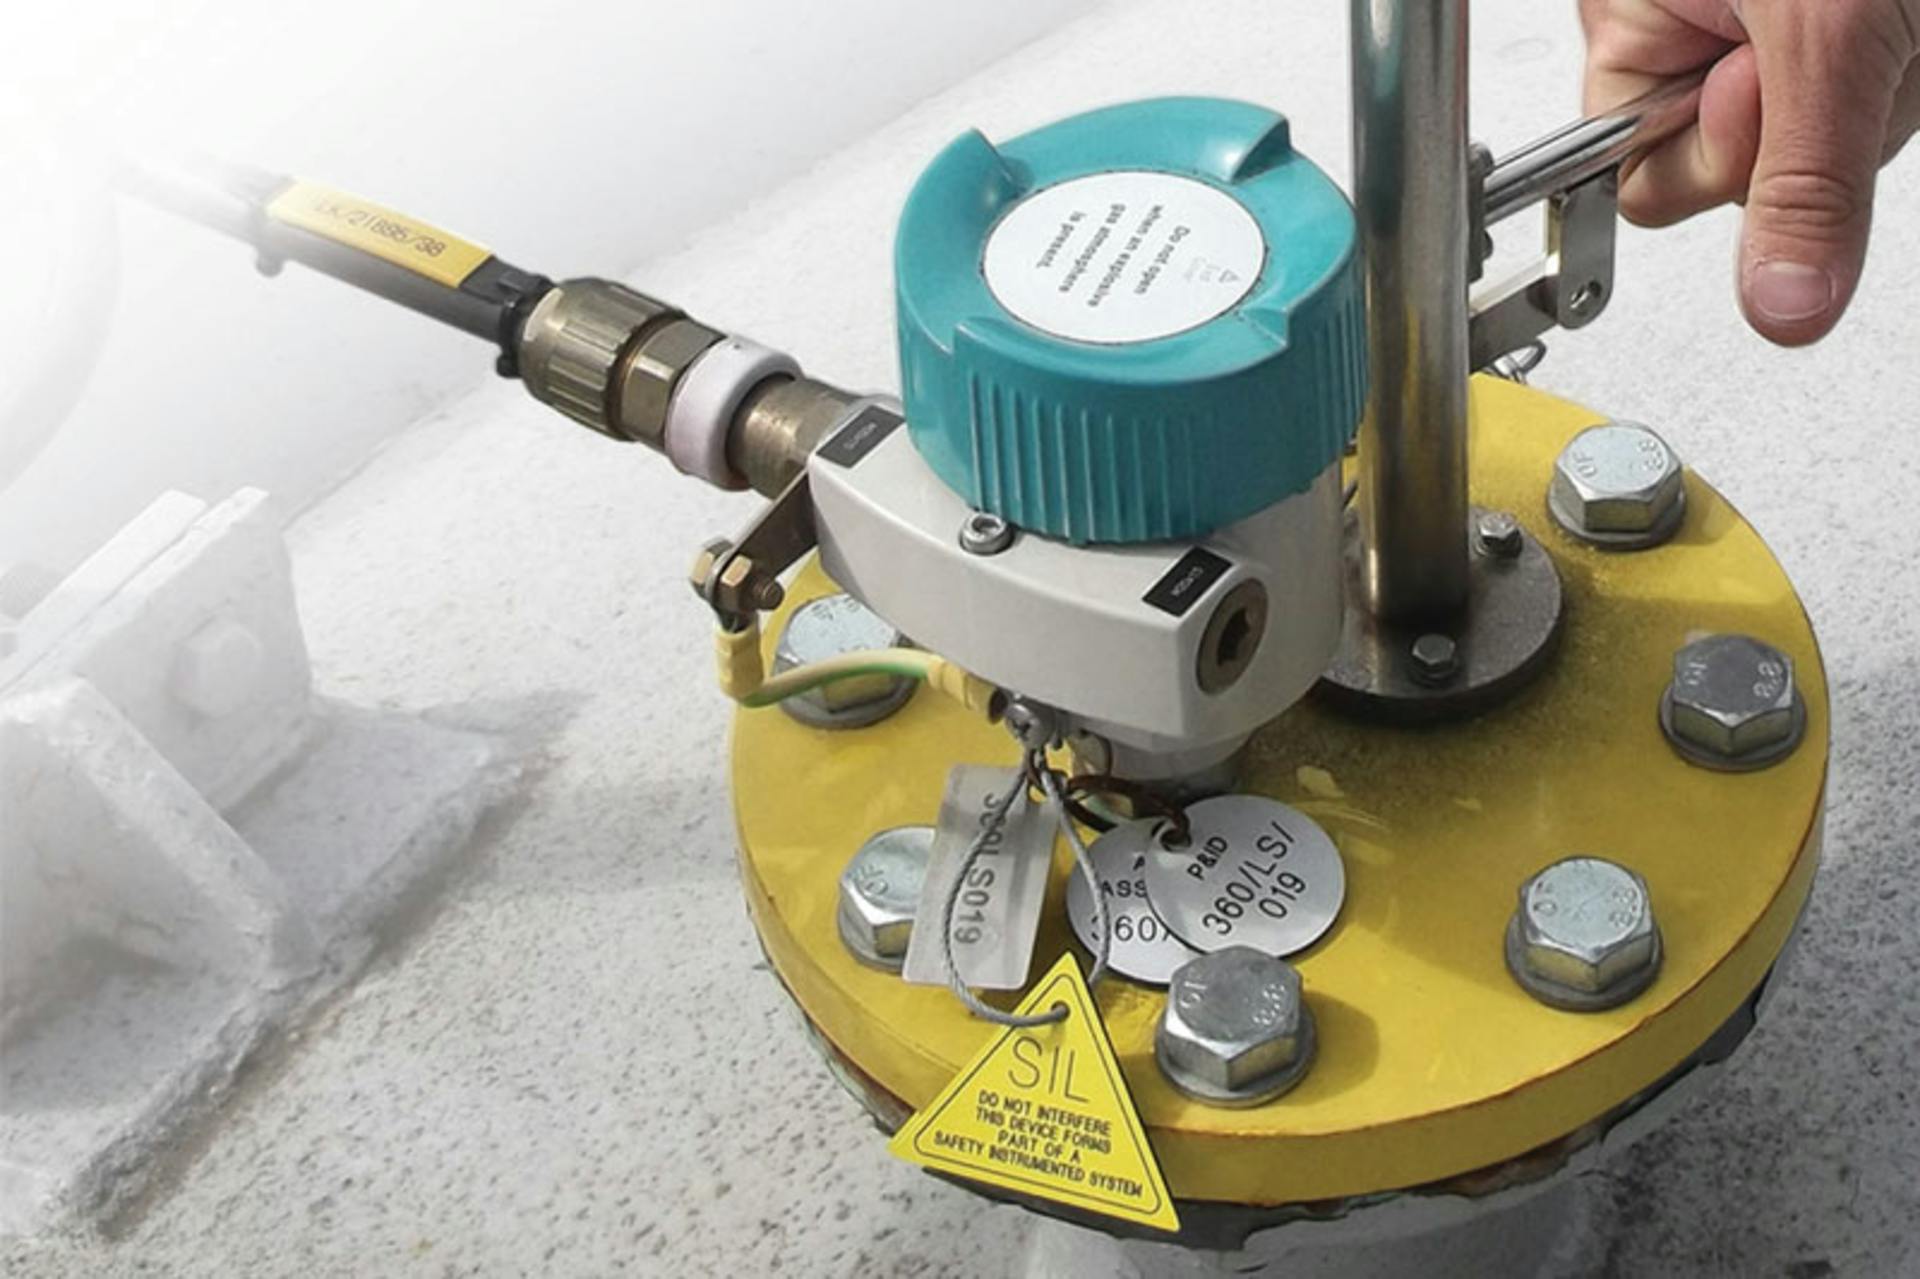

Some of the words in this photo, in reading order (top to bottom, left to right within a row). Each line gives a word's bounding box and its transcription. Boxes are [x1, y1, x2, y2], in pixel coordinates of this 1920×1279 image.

[1106, 203, 1126, 224] gas
[1136, 205, 1163, 234] when
[1169, 225, 1191, 243] Do
[1036, 223, 1075, 268] present.
[1058, 226, 1110, 292] atmosphere
[1125, 236, 1142, 251] an
[1153, 244, 1174, 264] not
[1087, 253, 1131, 307] explosive
[1133, 265, 1161, 294] open
[1187, 836, 1228, 880] P&ID
[1203, 820, 1295, 936] 360/LS/
[1259, 872, 1306, 919] 019
[1008, 1036, 1089, 1103] SIL
[976, 1106, 1004, 1127] THIS
[1009, 1117, 1058, 1141] DEVICE
[1063, 1129, 1112, 1154] FORMS
[978, 1089, 999, 1106] DO
[1003, 1096, 1032, 1114] NOT
[1037, 1105, 1112, 1135] INTERFERE
[934, 1130, 985, 1155] SAFETY
[988, 1146, 1086, 1182] INSTRUMENTED
[1089, 1171, 1143, 1197] SYSTEM
[998, 1131, 1038, 1153] PART
[1043, 1142, 1063, 1158] OF
[1069, 1150, 1081, 1164] A
